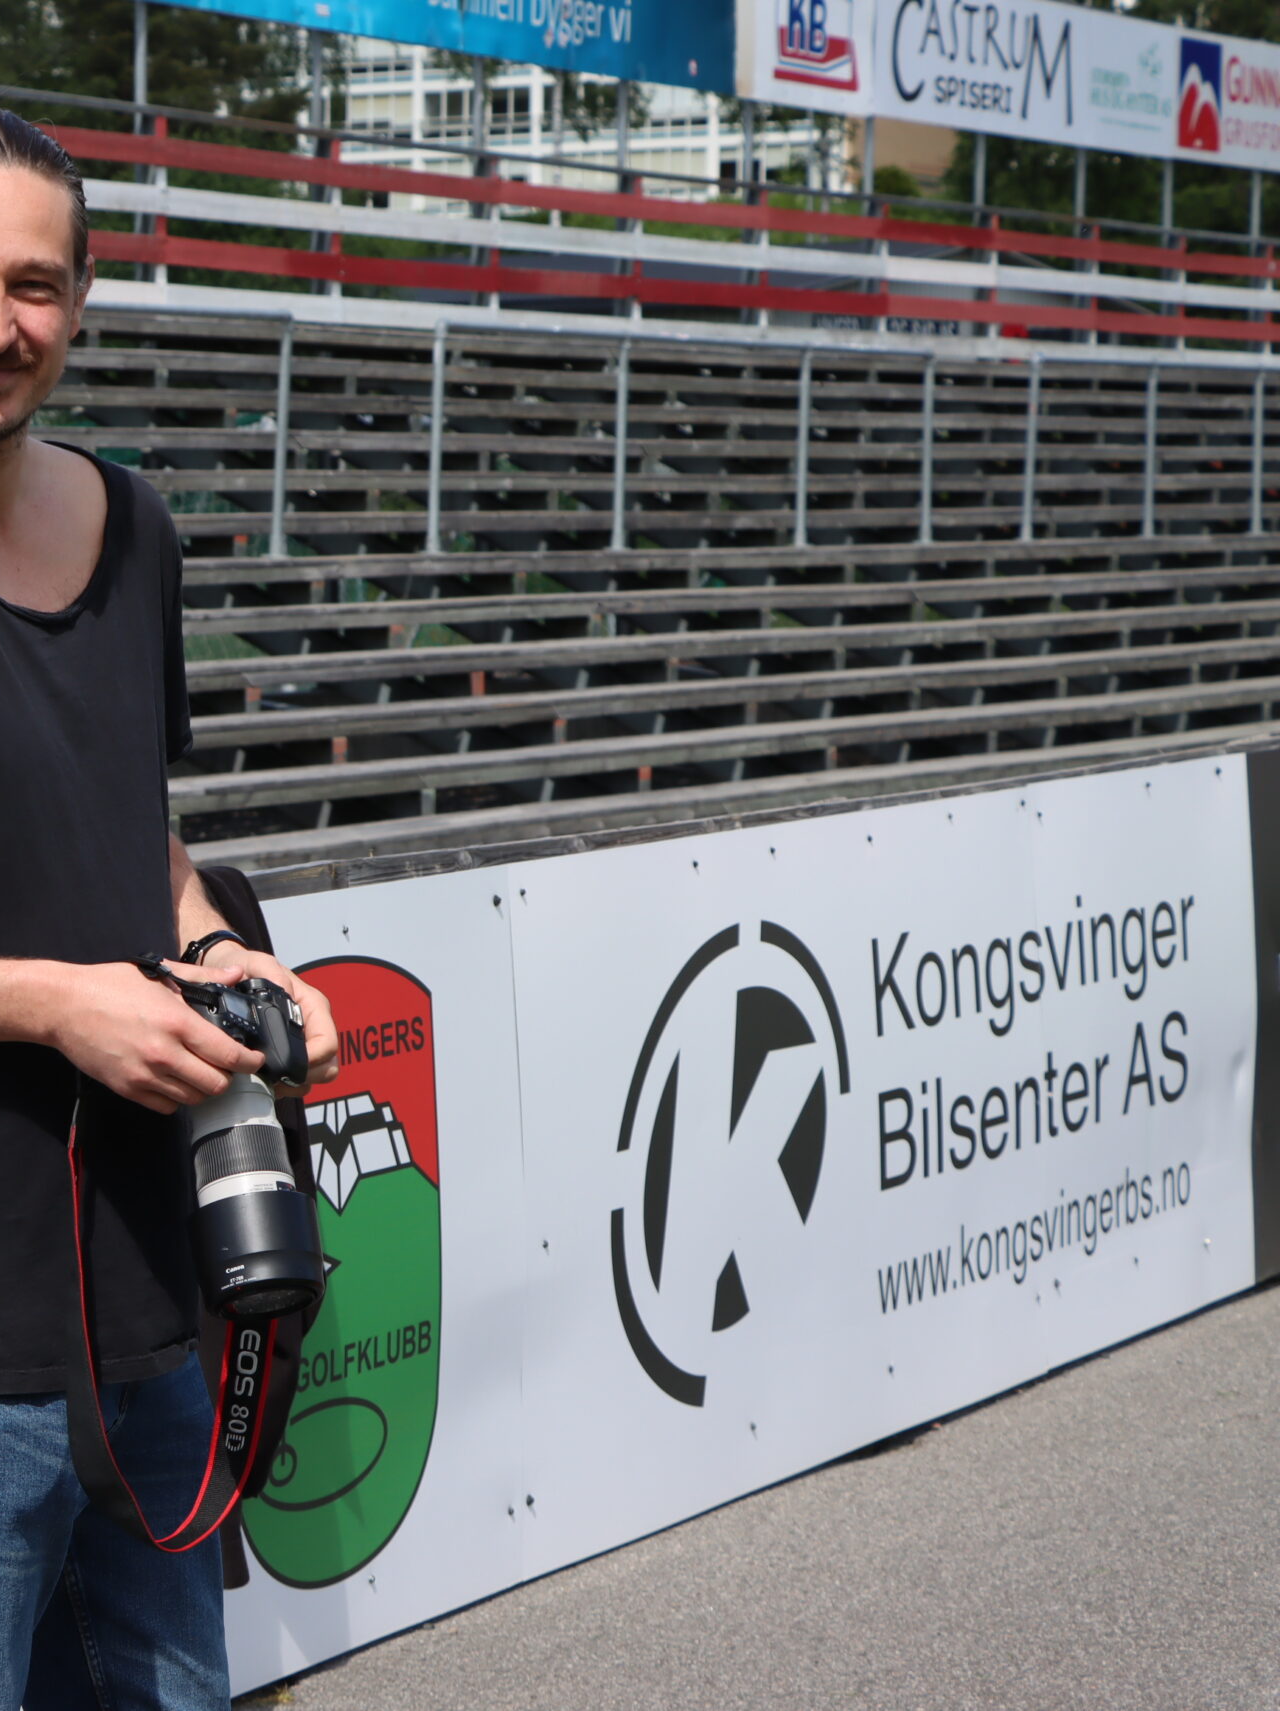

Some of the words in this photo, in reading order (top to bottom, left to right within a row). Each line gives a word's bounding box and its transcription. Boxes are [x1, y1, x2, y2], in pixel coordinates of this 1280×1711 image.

[609, 0, 633, 43] vi
[892, 0, 1073, 126] CASTRUM
[934, 75, 1012, 113] SPISERI
[871, 894, 1195, 1037] Kongsvinger
[337, 1016, 425, 1067] INGERS
[878, 1051, 1110, 1191] Bilsenter
[1123, 1010, 1189, 1115] AS
[878, 1161, 1190, 1315] www.kongsvingerbs.no
[233, 1329, 261, 1397] EOS
[296, 1320, 432, 1393] GOLFKLUBB
[225, 1404, 250, 1452] 80D
